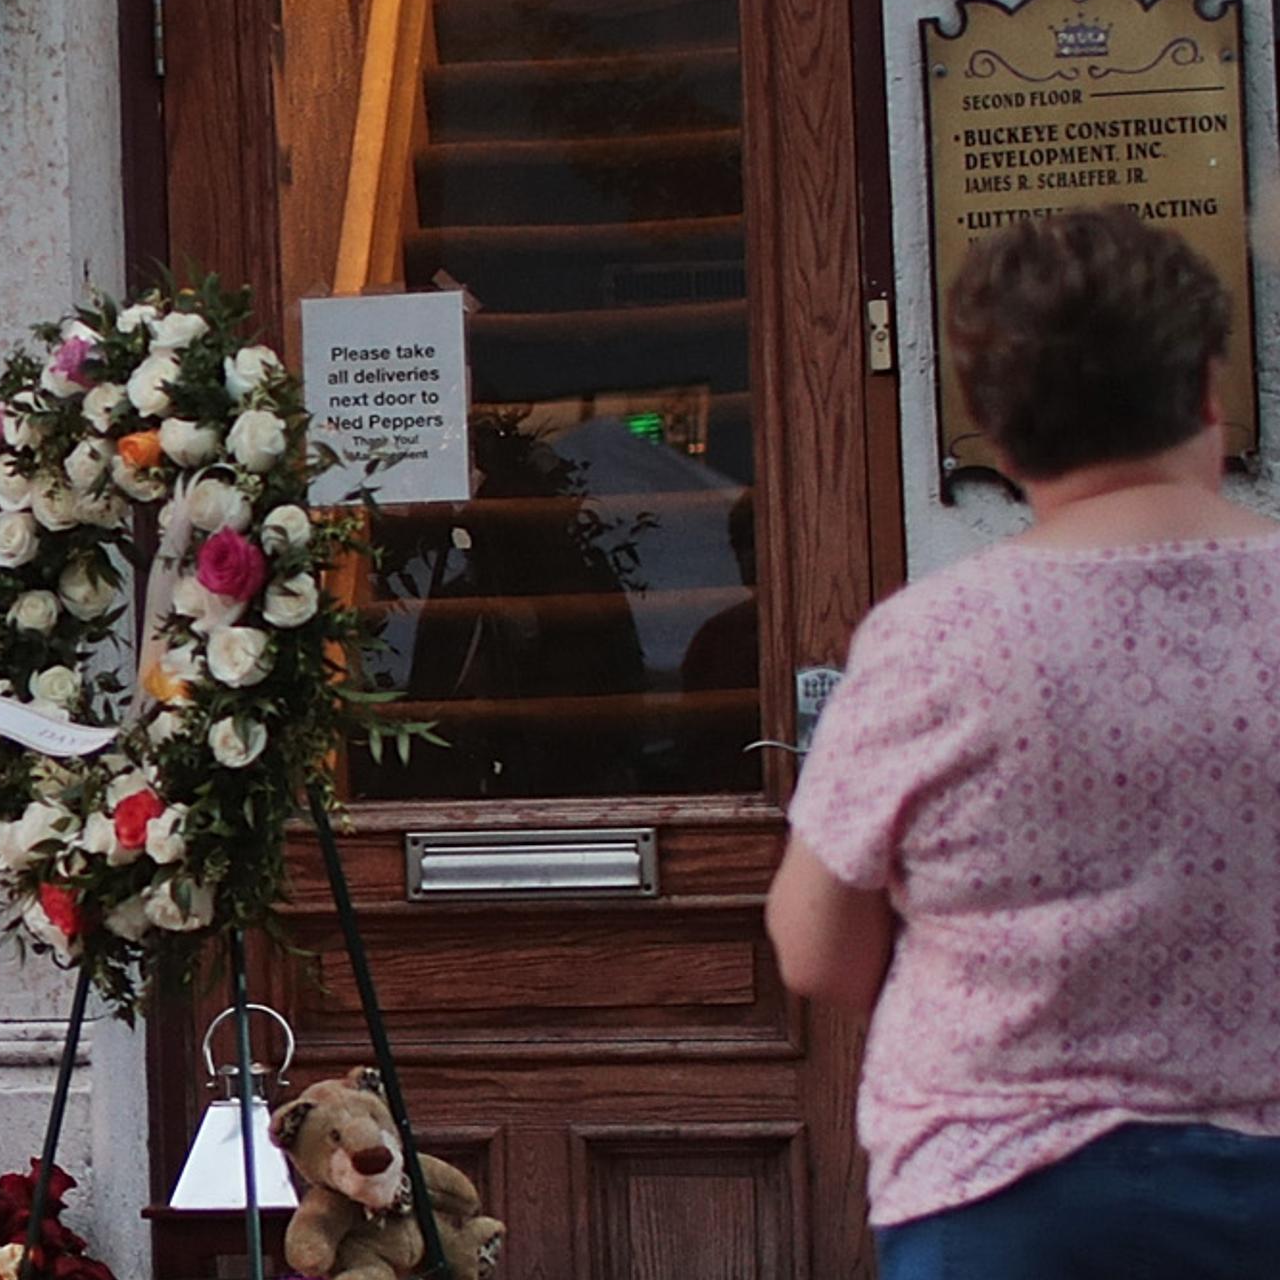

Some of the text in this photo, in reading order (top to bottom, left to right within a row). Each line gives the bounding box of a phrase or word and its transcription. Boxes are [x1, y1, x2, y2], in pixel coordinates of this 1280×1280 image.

[962, 88, 1083, 112] SECOND FLOOR
[964, 114, 1228, 147] BUCKEYE CONSTRUCTION
[965, 174, 1013, 194] JAMES
[967, 206, 1065, 231] LUTTREL
[331, 343, 436, 362] Please take
[327, 366, 440, 385] all deliveries
[328, 390, 439, 407] next door to
[327, 412, 444, 432] Ned Peppers
